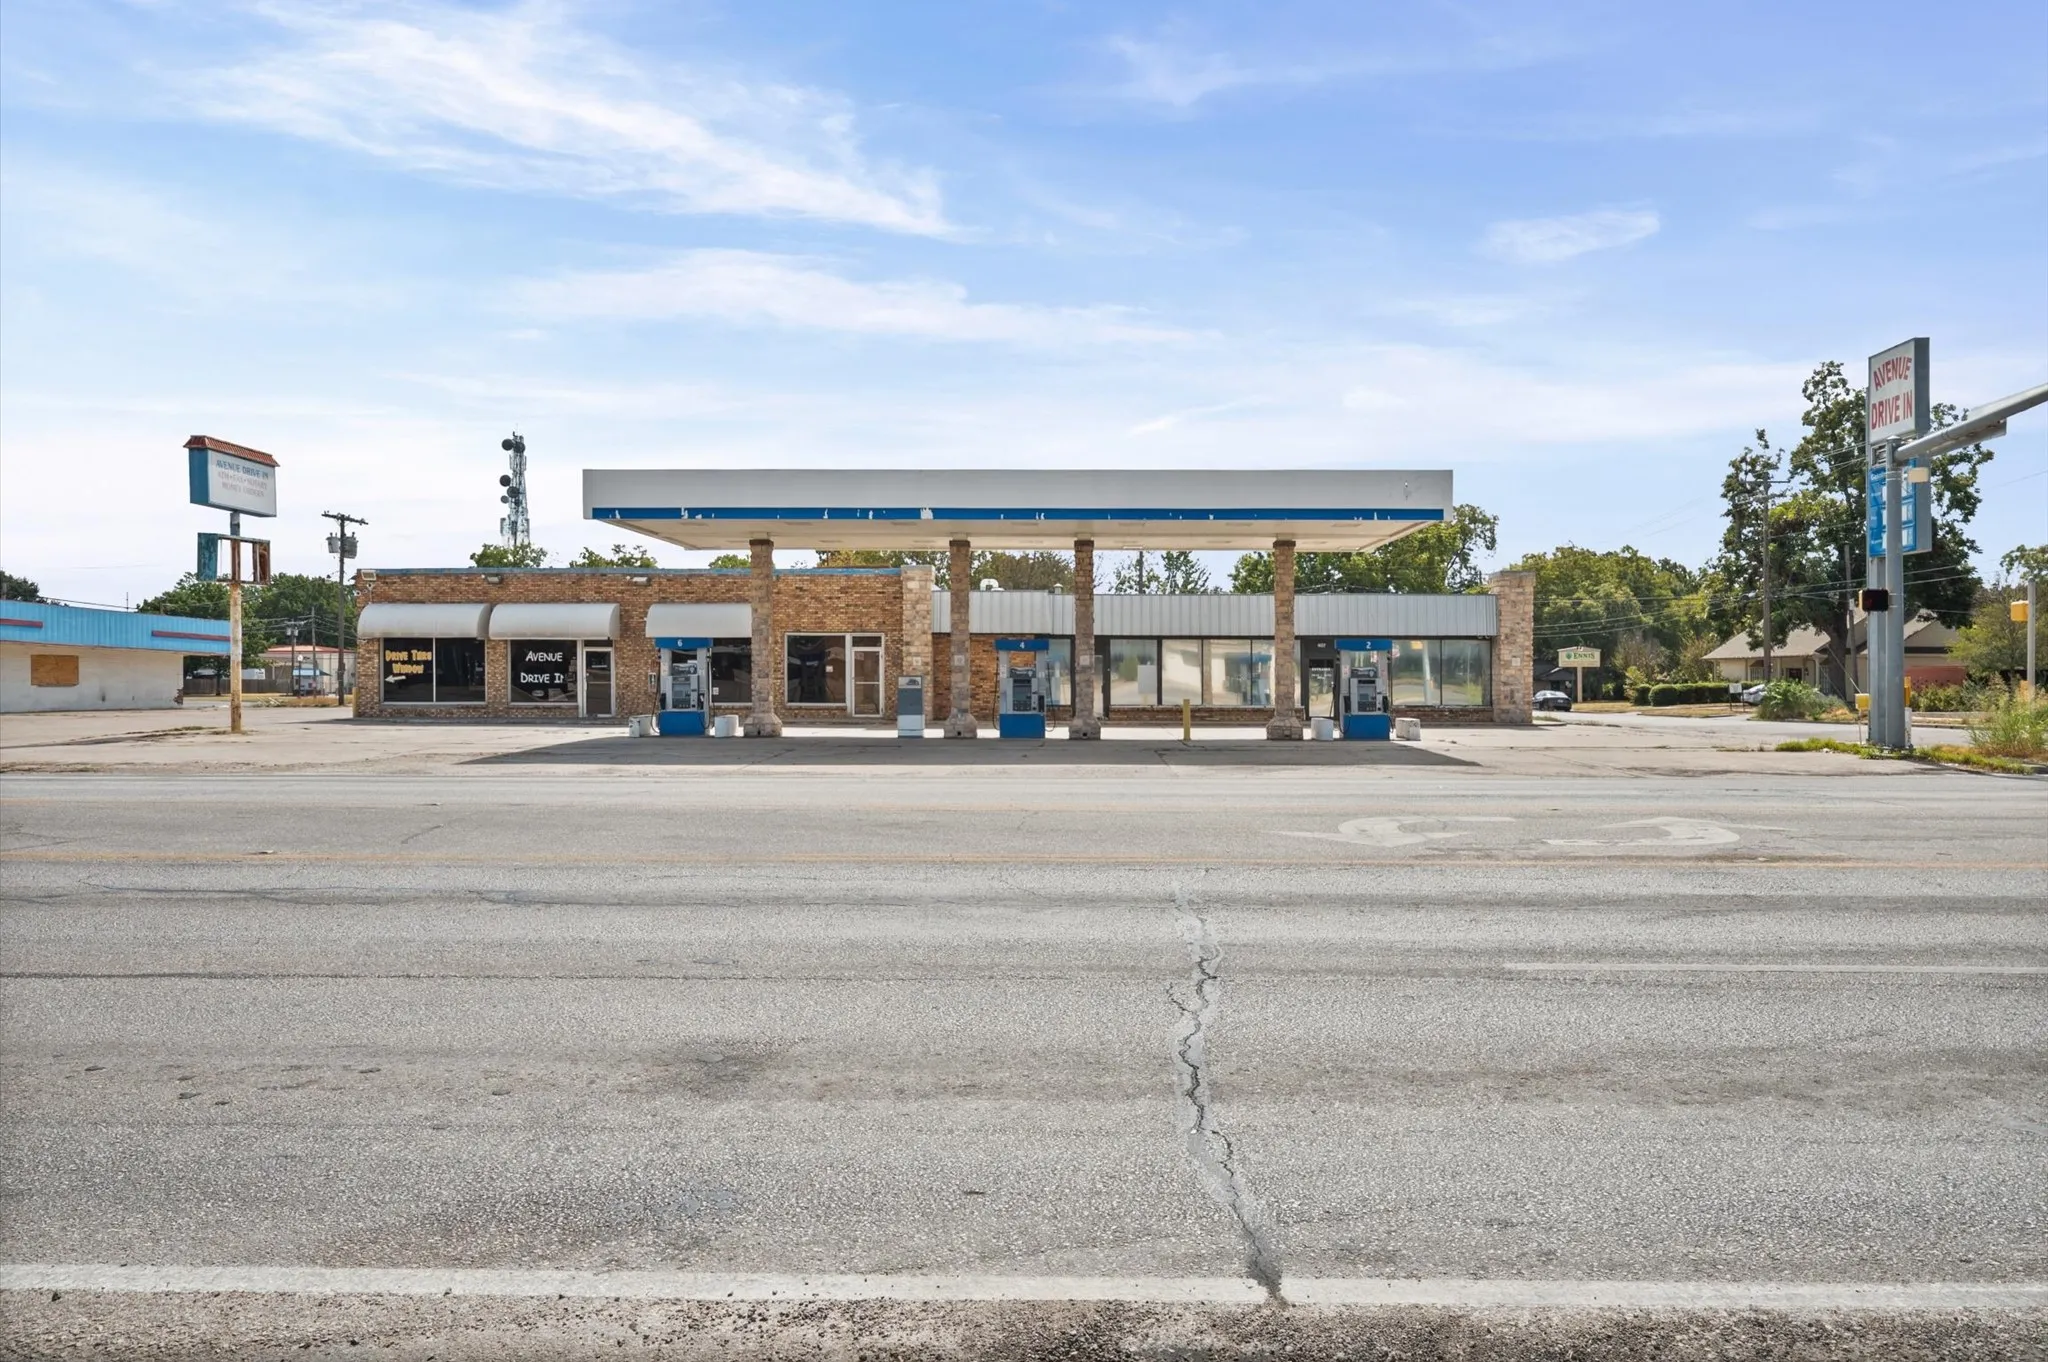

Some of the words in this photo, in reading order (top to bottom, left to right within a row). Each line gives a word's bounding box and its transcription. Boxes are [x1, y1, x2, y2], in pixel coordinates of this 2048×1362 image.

[1873, 356, 1912, 391] AVENUE
[1871, 395, 1900, 430] DRIVE
[1903, 389, 1912, 420] IN
[216, 460, 241, 473] AVENUE
[242, 466, 261, 478] DRIVE
[262, 470, 269, 480] IN
[677, 639, 683, 647] 6
[1020, 641, 1025, 649] 4
[1366, 641, 1372, 649] 2
[385, 649, 408, 661] DRIVE
[525, 651, 563, 662] AVENUE
[1573, 652, 1596, 660] ENNIS
[392, 662, 424, 674] WINDOW
[520, 672, 550, 684] DRIVE
